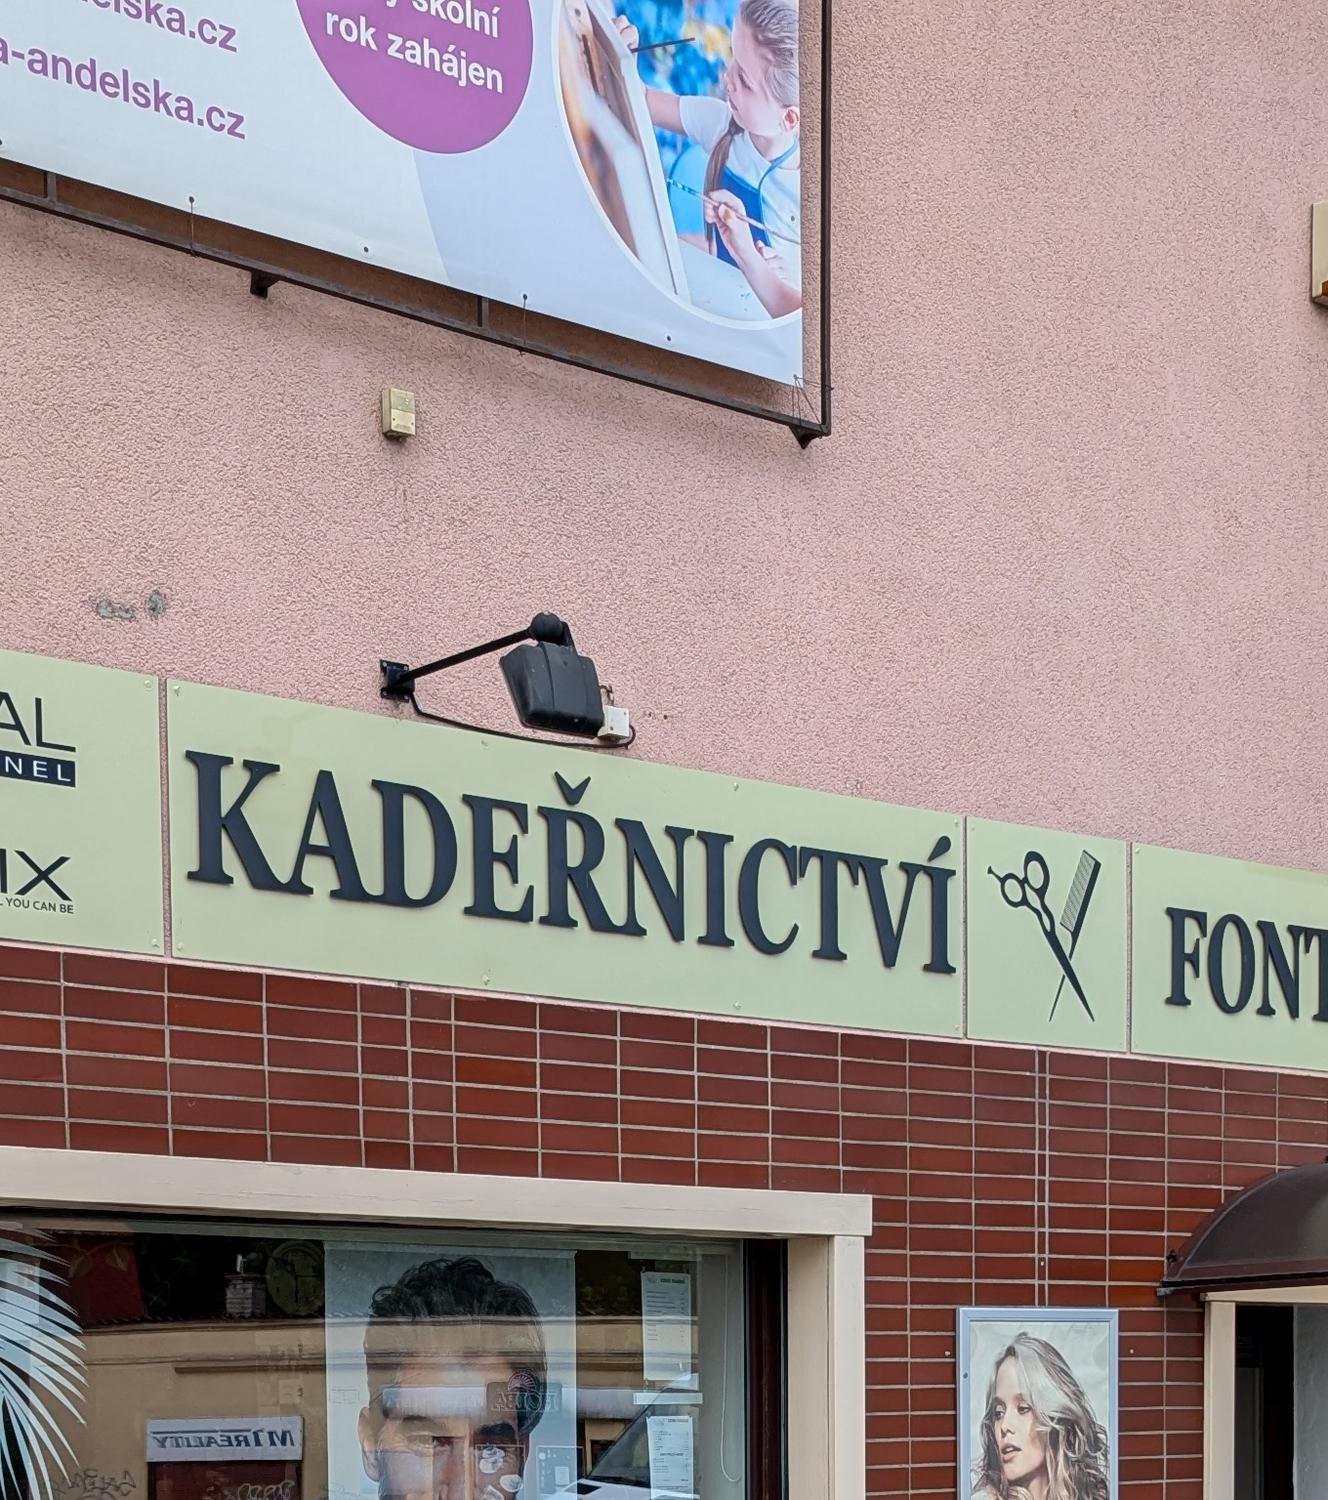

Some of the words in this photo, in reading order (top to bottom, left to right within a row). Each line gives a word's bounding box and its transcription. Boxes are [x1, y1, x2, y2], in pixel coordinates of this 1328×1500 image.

[326, 12, 377, 50] rok
[387, 33, 503, 94] zahájen
[184, 749, 958, 975] KADEŘNICTVÍ
[5, 897, 30, 909] YOU
[32, 900, 57, 913] CAN
[59, 903, 74, 915] BE
